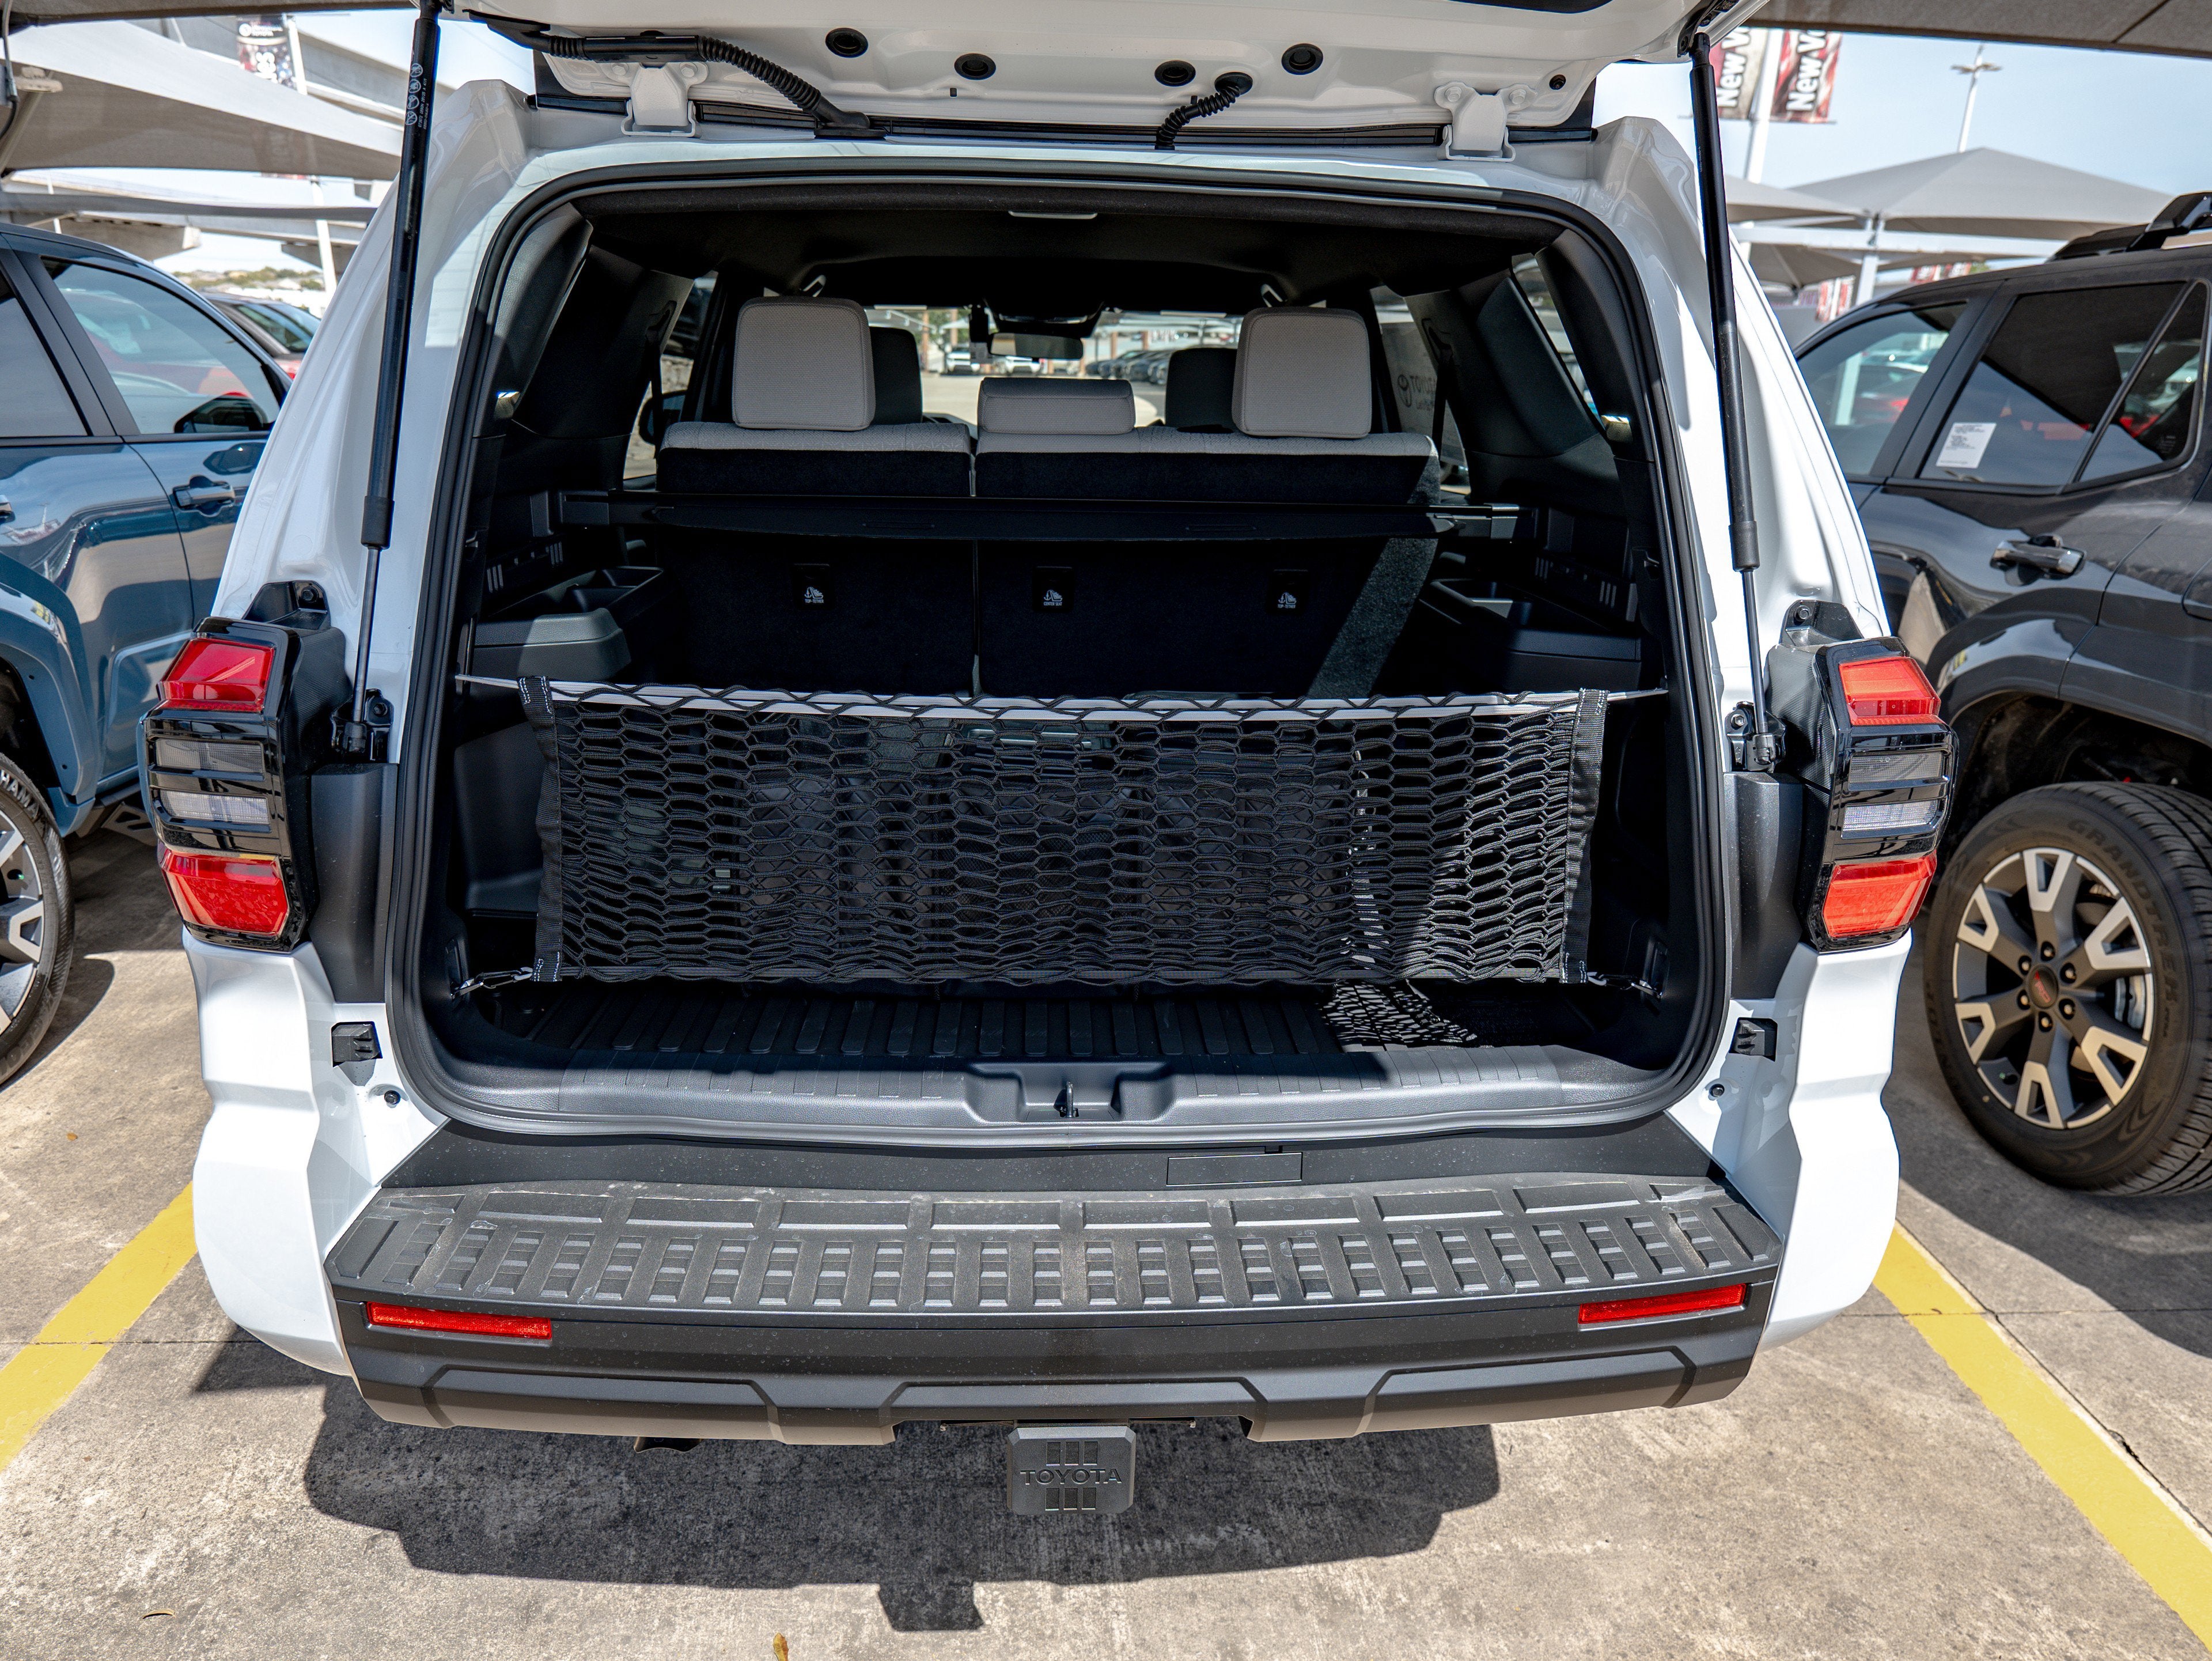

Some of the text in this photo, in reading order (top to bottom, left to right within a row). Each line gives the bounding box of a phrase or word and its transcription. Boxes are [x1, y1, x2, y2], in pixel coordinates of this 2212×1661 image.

[1716, 27, 1750, 108] New V
[1787, 56, 1823, 111] New
[1020, 1468, 1122, 1486] TOYOTA
